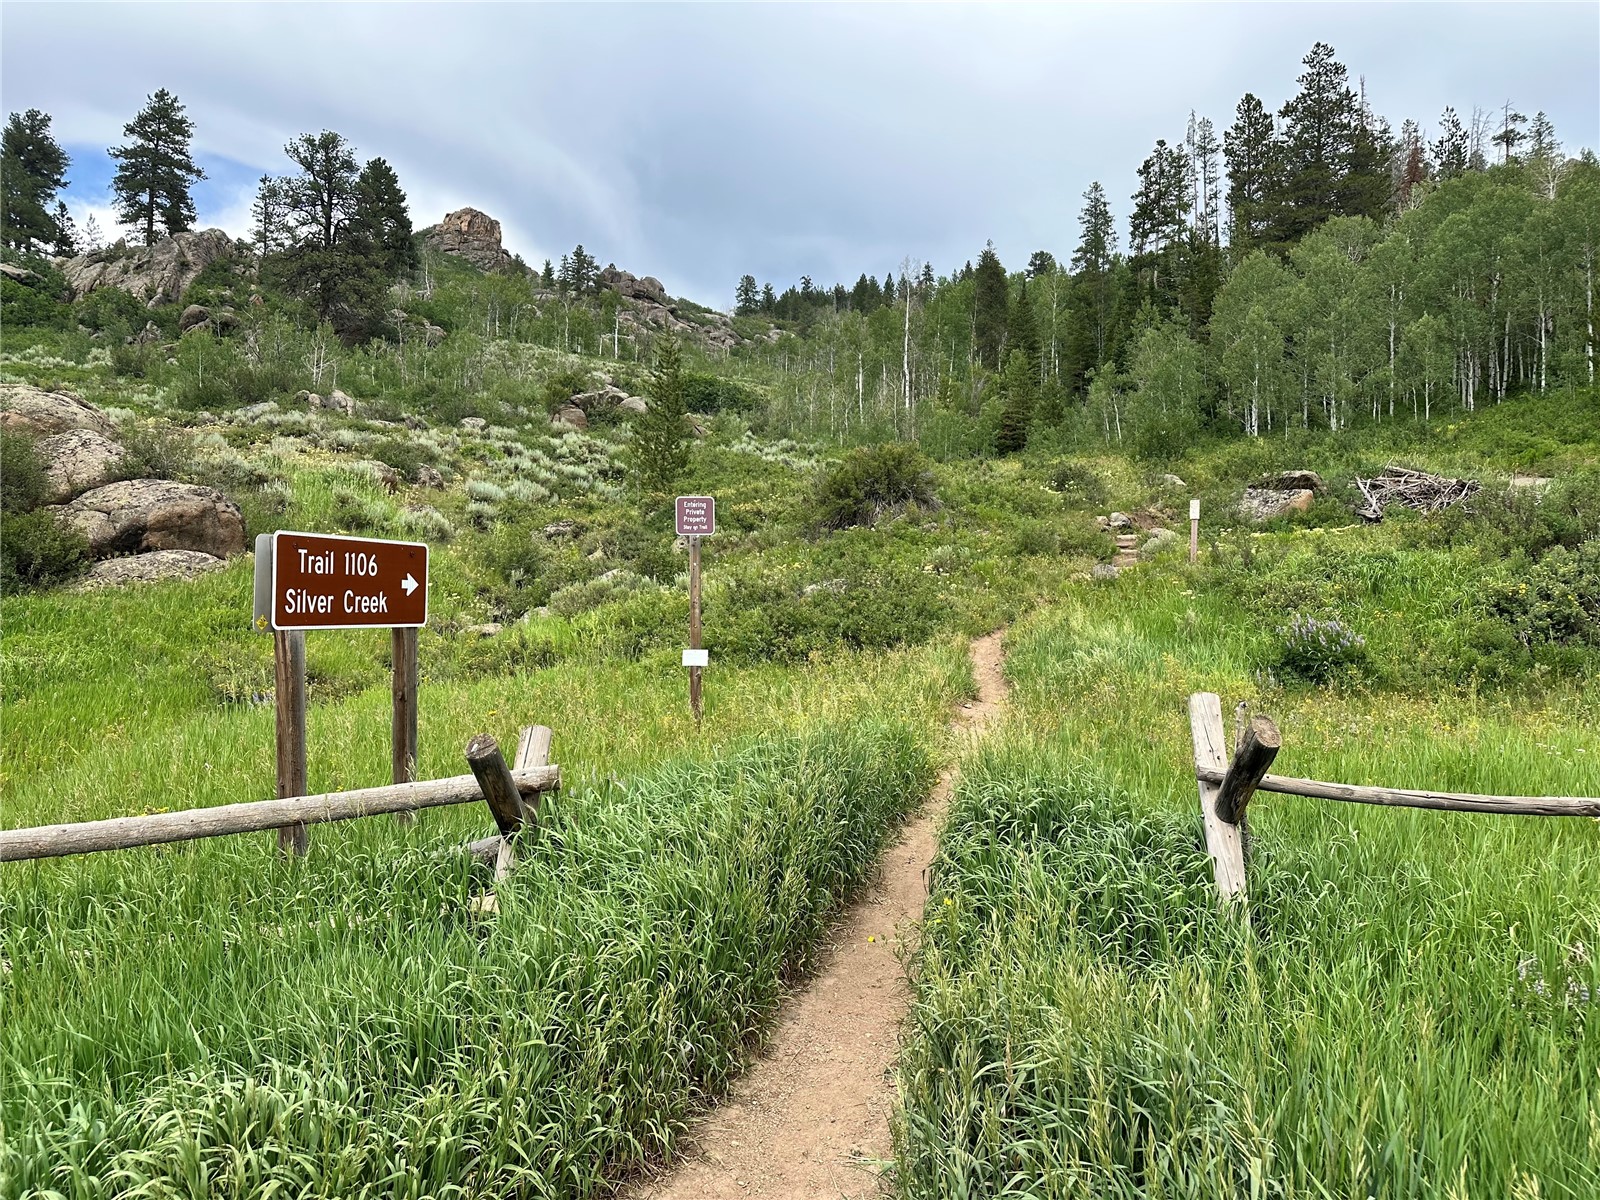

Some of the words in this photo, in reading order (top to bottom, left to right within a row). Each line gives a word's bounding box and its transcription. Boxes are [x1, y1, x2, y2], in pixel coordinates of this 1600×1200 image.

[298, 549, 334, 574] Trail
[344, 552, 378, 576] 1106
[284, 588, 335, 614] Silver
[343, 589, 388, 614] Creek
